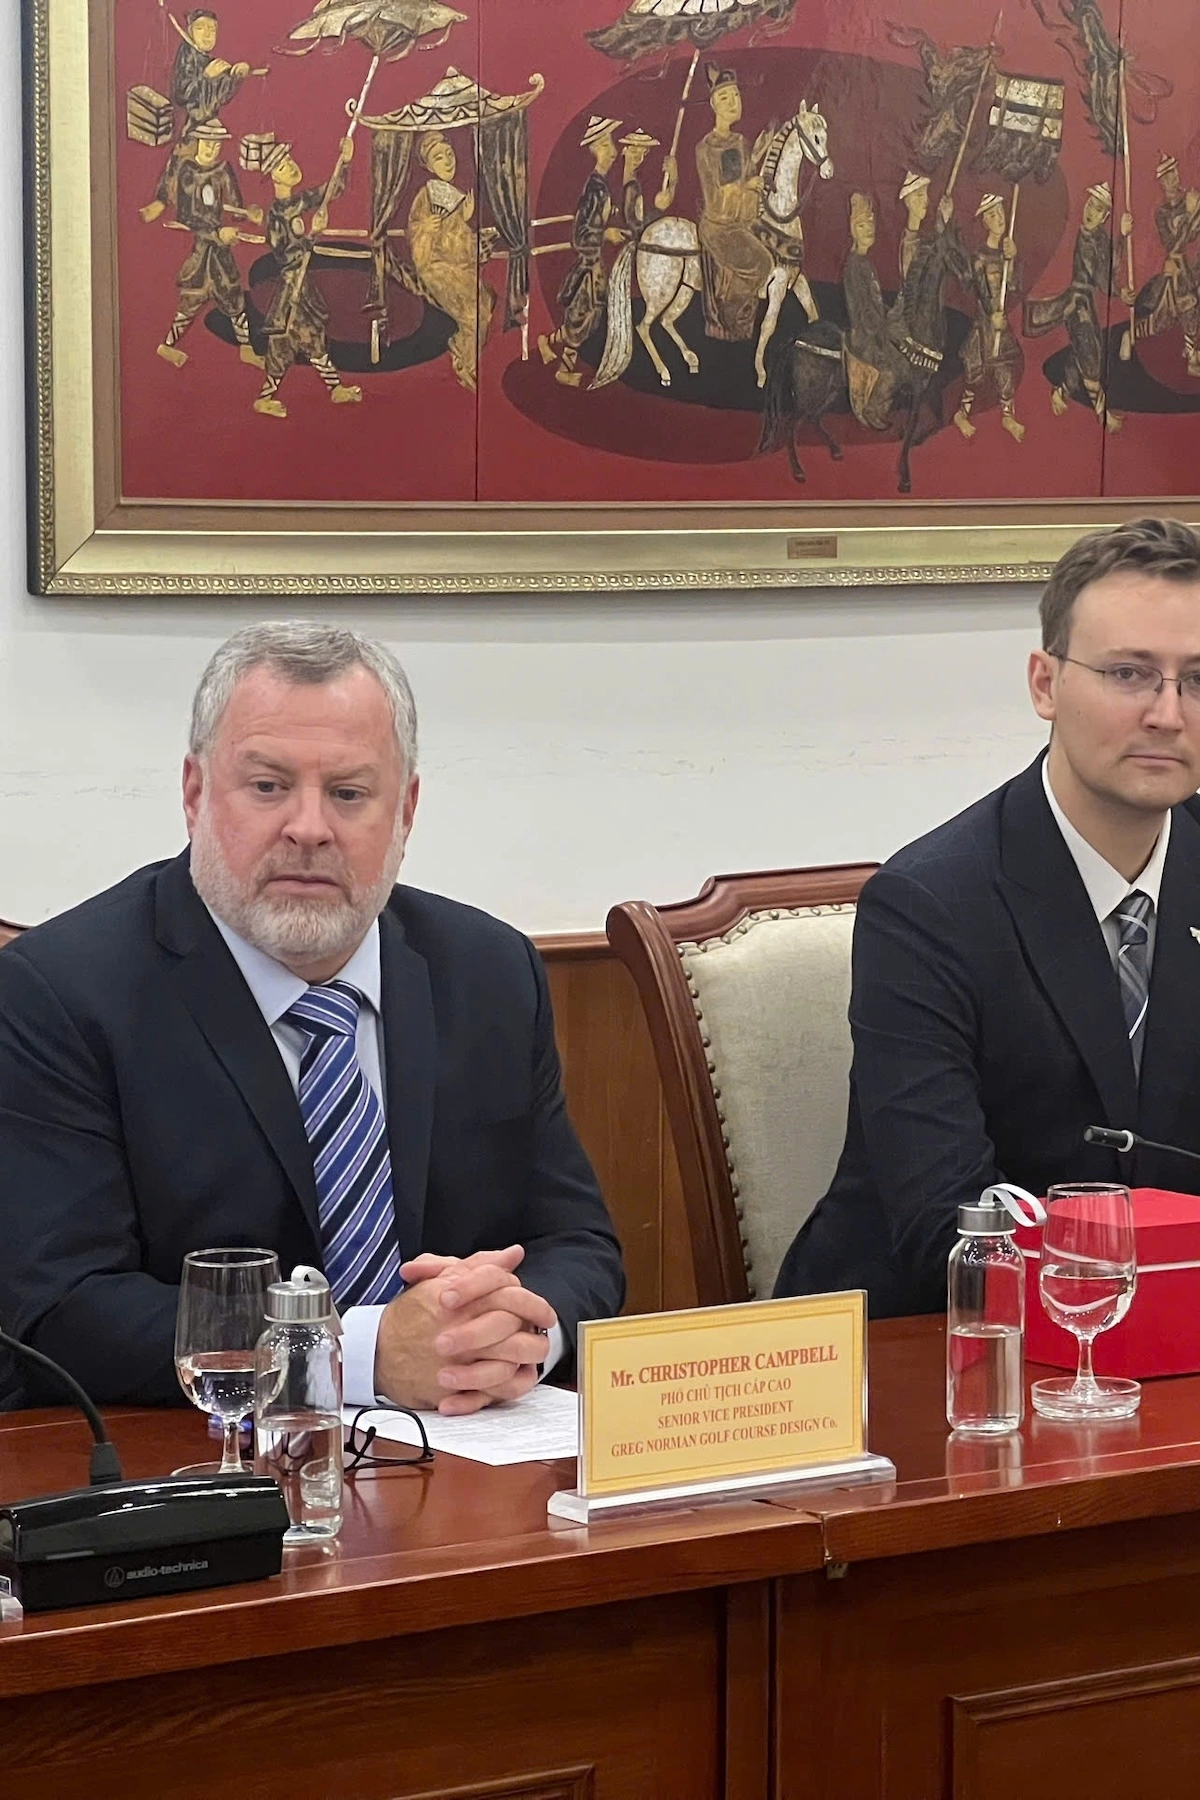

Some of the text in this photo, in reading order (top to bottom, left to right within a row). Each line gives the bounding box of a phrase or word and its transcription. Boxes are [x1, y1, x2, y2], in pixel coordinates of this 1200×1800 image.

[611, 1345, 838, 1388] Mr. CHRISTOPHER CAMPBELL
[768, 1378, 791, 1392] CAO
[658, 1400, 793, 1429] SENIOR VICE PRESIDENT
[611, 1416, 838, 1457] GREG NORMAN GOLF COURSE DESIGN Co.
